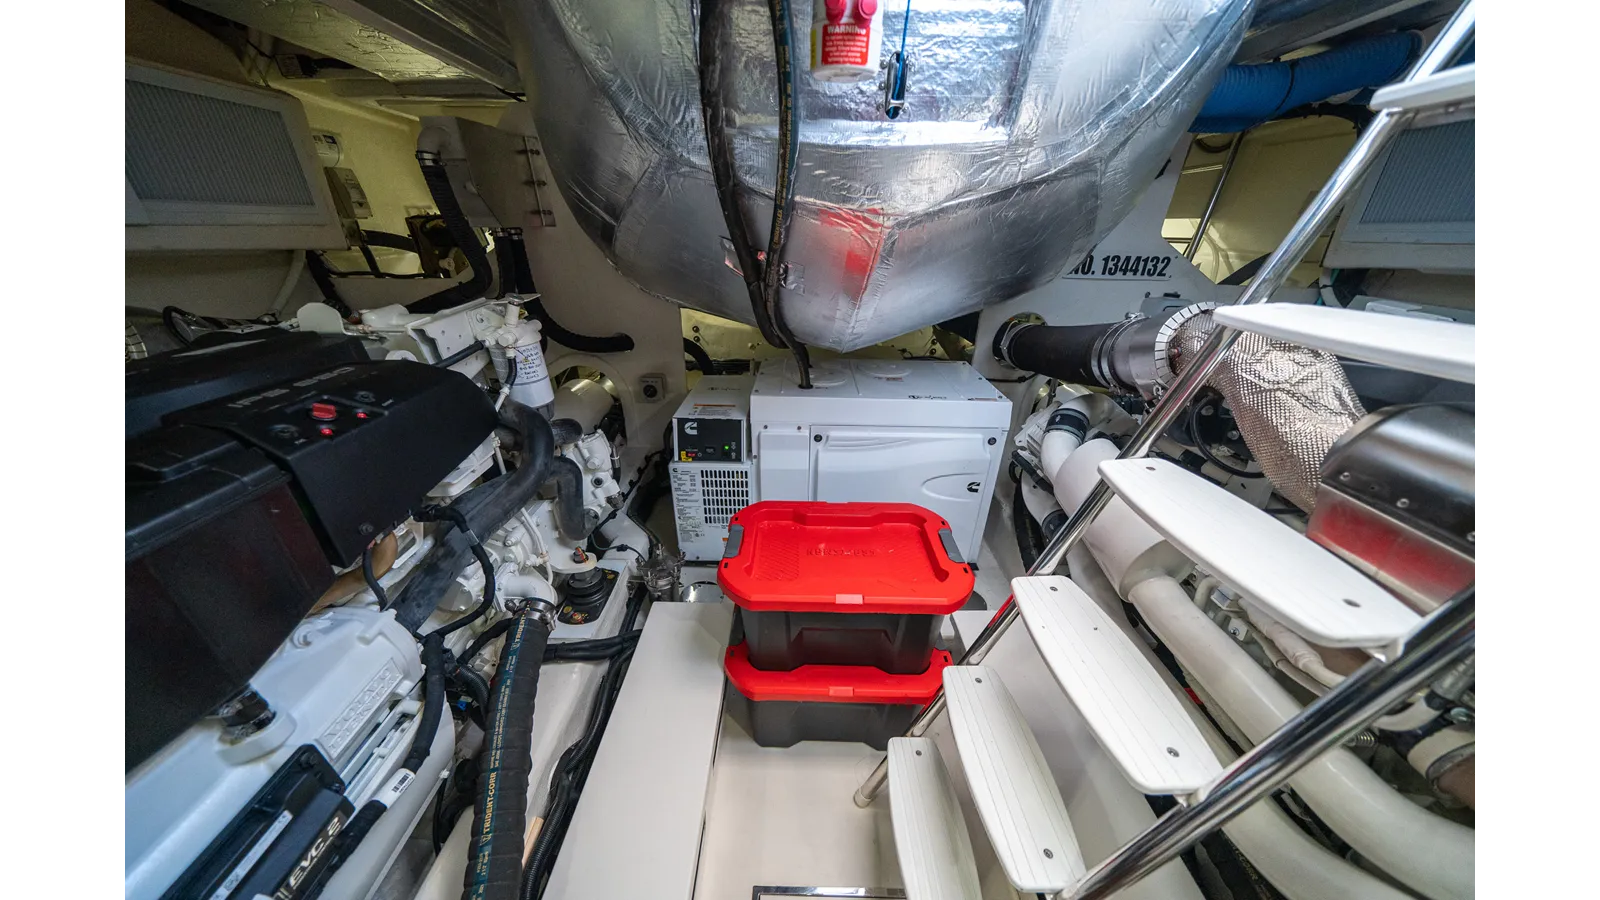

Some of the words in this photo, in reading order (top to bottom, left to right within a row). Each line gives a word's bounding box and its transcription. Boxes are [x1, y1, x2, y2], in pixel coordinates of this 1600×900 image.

[1101, 255, 1171, 277] 1344132
[324, 667, 392, 738] VOLVO
[483, 771, 497, 834] TRIDENT-CORR
[289, 837, 325, 886] EVC
[327, 816, 341, 836] 2
